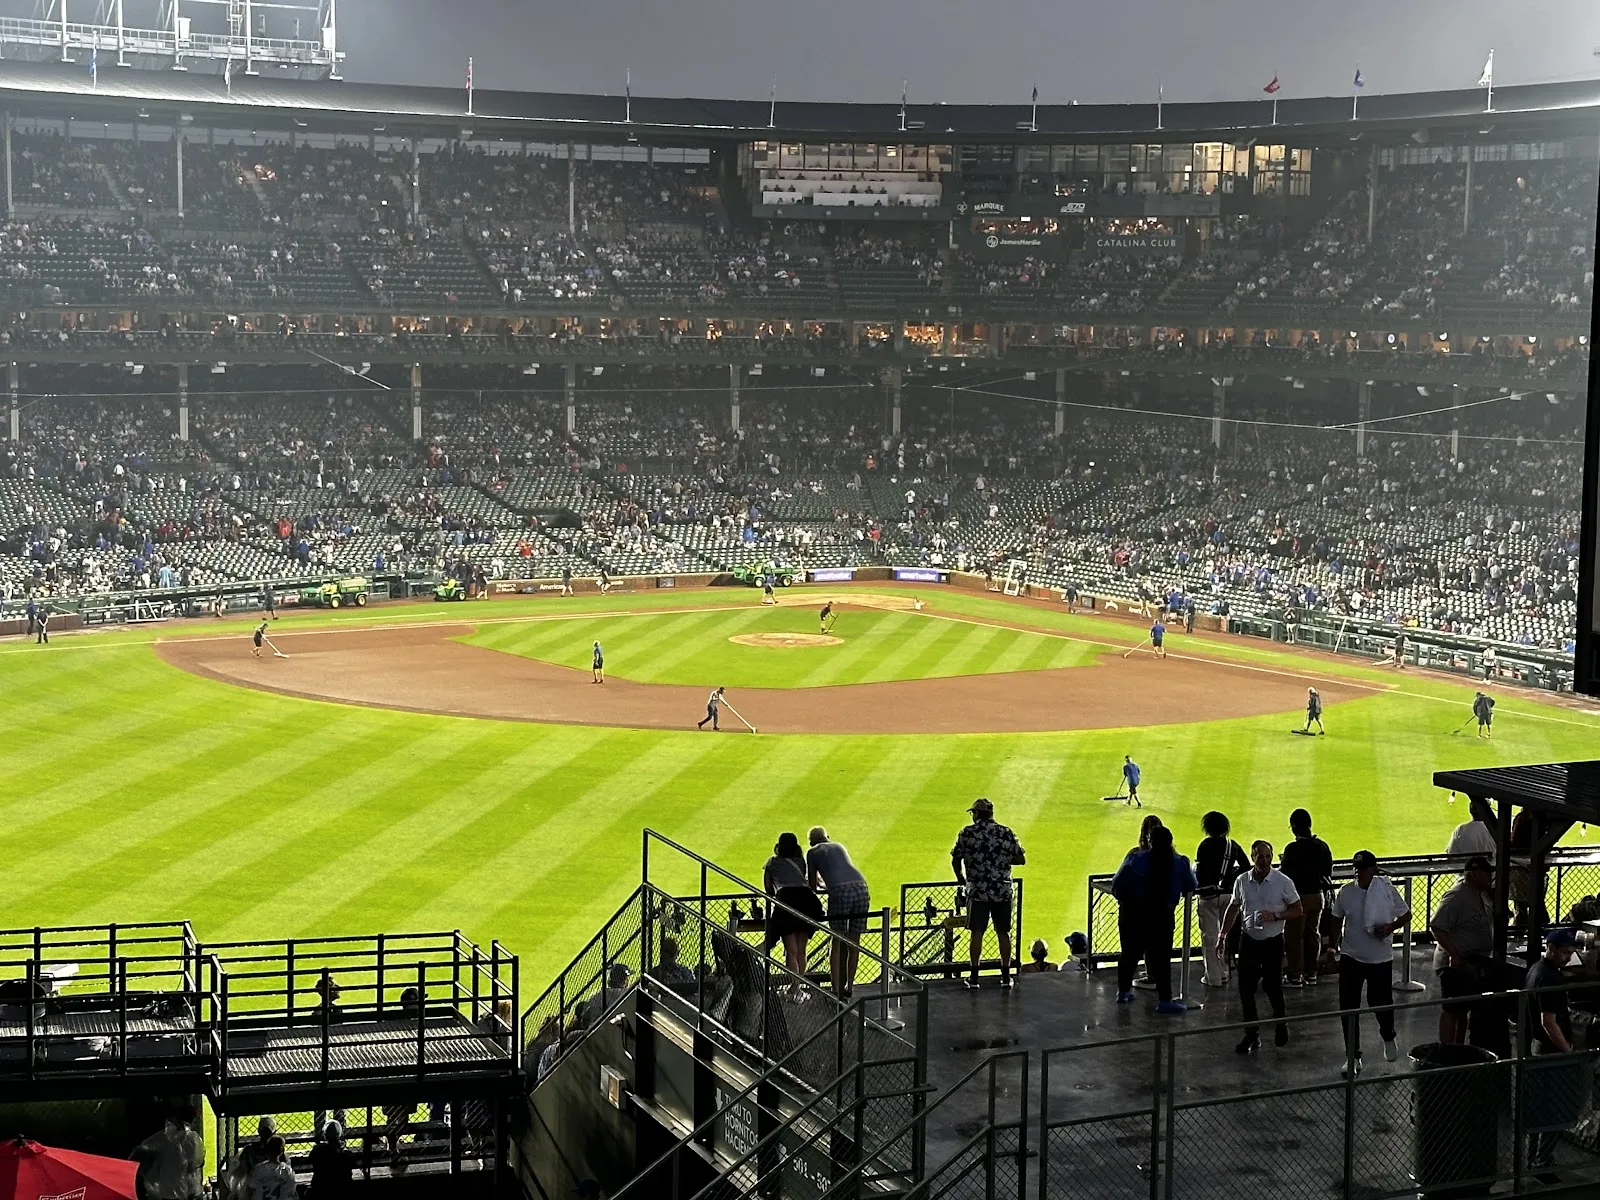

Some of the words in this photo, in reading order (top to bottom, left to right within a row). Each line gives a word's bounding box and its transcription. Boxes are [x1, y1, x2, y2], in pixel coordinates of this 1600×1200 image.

[973, 202, 1005, 212] MARQUEE
[1096, 239, 1147, 247] CATALINA
[1150, 239, 1177, 247] CLUB
[742, 1107, 752, 1125] TO
[724, 1111, 759, 1146] HORNITOS
